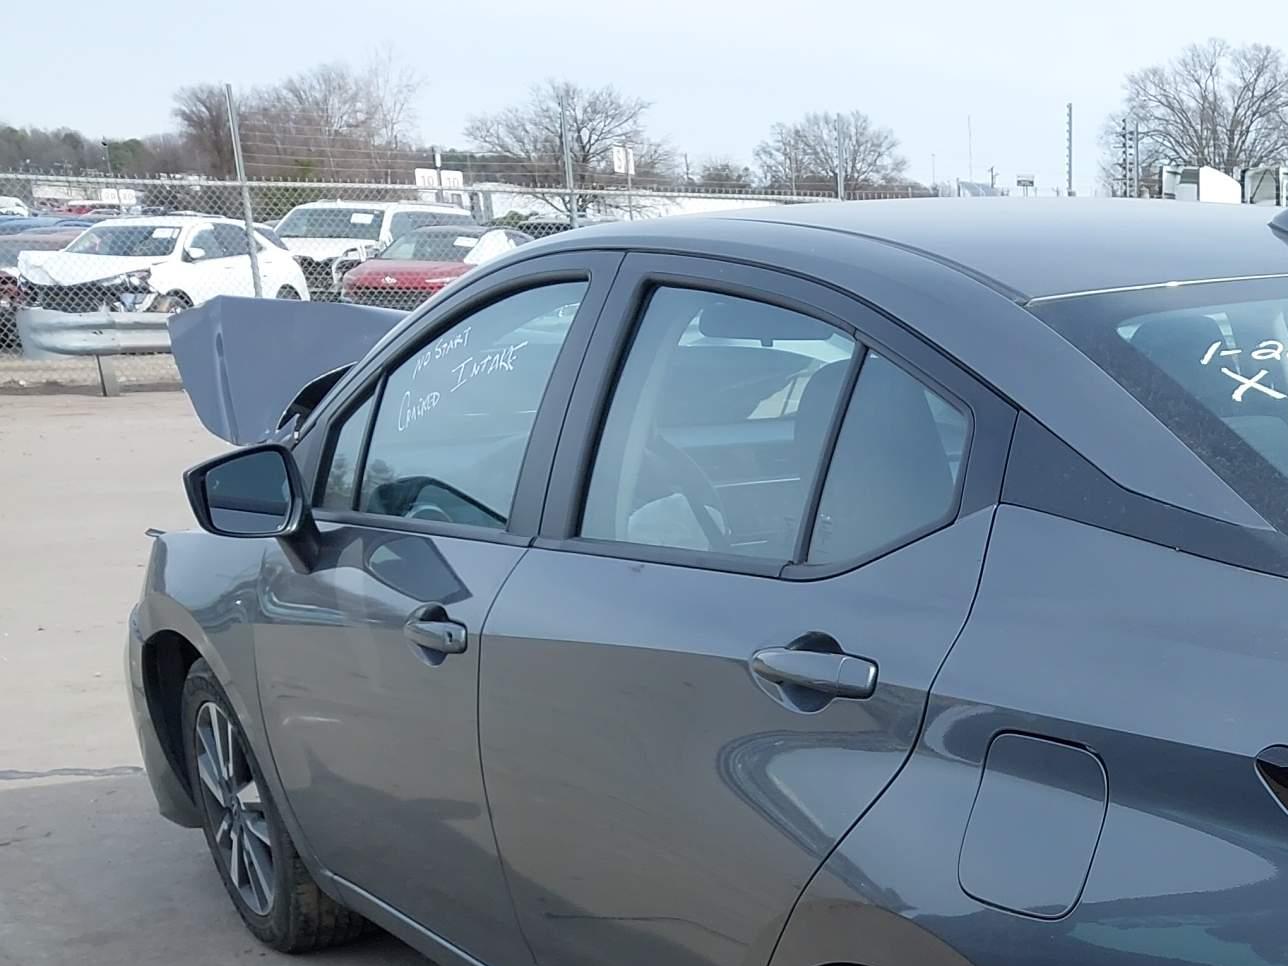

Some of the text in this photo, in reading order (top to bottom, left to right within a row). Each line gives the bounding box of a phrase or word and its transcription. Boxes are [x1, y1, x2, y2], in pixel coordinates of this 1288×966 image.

[434, 326, 472, 359] START
[451, 341, 529, 392] INTAKE
[1221, 367, 1288, 402] X
